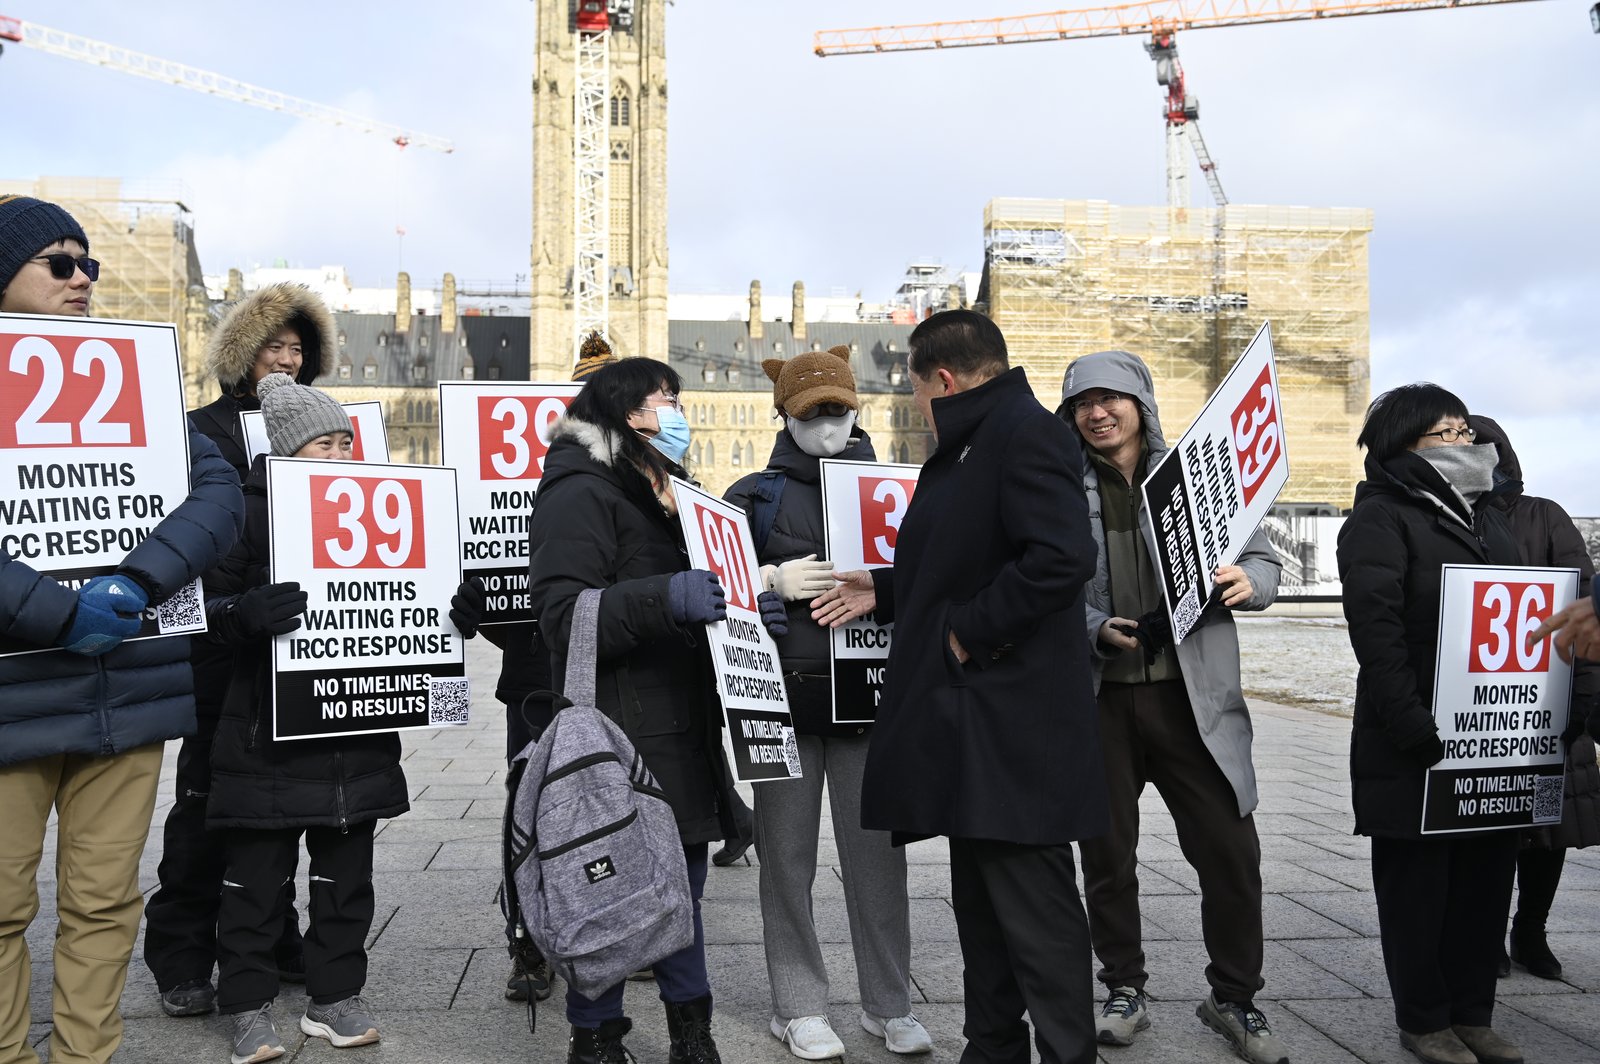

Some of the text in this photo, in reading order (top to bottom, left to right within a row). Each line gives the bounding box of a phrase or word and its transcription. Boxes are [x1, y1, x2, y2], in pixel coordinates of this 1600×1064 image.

[9, 336, 132, 445] 22
[490, 397, 567, 478] 39
[1234, 383, 1278, 488] 39
[17, 462, 136, 490] MONTHS
[1217, 436, 1239, 519] MONTHS
[117, 494, 165, 519] FOR
[490, 491, 536, 510] MON
[1201, 432, 1230, 555] WAITING FOR
[324, 477, 414, 567] 39
[872, 479, 906, 564] 3
[1185, 439, 1219, 583] IRCC RESPONSE
[469, 515, 531, 535] WAITI
[1170, 483, 1198, 589] NO TIMELINES
[1, 527, 150, 560] CC RESPON
[463, 541, 501, 560] RCC
[1160, 504, 1186, 598] NO RESULTS
[702, 508, 750, 609] 90
[327, 581, 417, 602] MONTHS
[486, 596, 508, 611] NO
[304, 607, 440, 630] WAITING FOR
[726, 617, 761, 644] MONTHS
[1477, 583, 1546, 672] 36
[289, 633, 452, 660] IRCC RESPONSE
[845, 628, 888, 649] IRCC
[722, 643, 775, 674] WAITING FOR
[313, 673, 433, 697] NO TIMELINES
[724, 673, 784, 702] IRCC RESPONSE
[1473, 684, 1538, 705] MONTHS
[322, 696, 426, 720] NO RESULTS
[1454, 710, 1551, 732] WAITING FOR
[740, 719, 783, 739] NO TIMELINES
[748, 745, 786, 764] NO RESULTS
[1479, 735, 1558, 758] RESPONSE
[1454, 778, 1473, 795] NO
[1458, 795, 1533, 816] NO RESULTS
